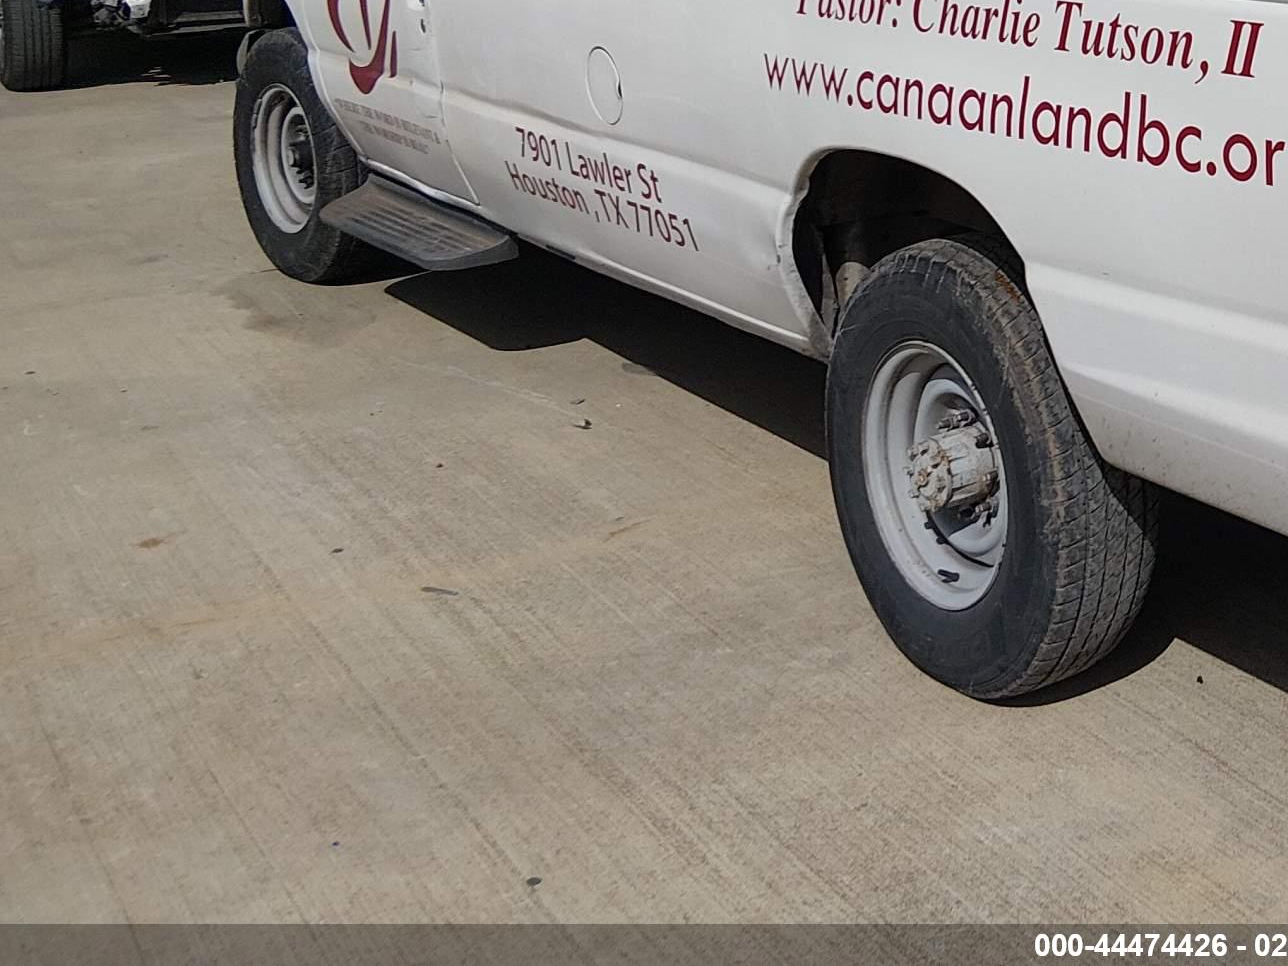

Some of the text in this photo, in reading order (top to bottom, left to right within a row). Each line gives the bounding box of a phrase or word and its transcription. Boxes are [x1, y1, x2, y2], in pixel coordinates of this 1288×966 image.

[1053, 0, 1210, 84] Tutson,
[1221, 19, 1265, 78] II
[514, 126, 663, 204] 7901 Lawler St
[627, 201, 700, 252] 77051
